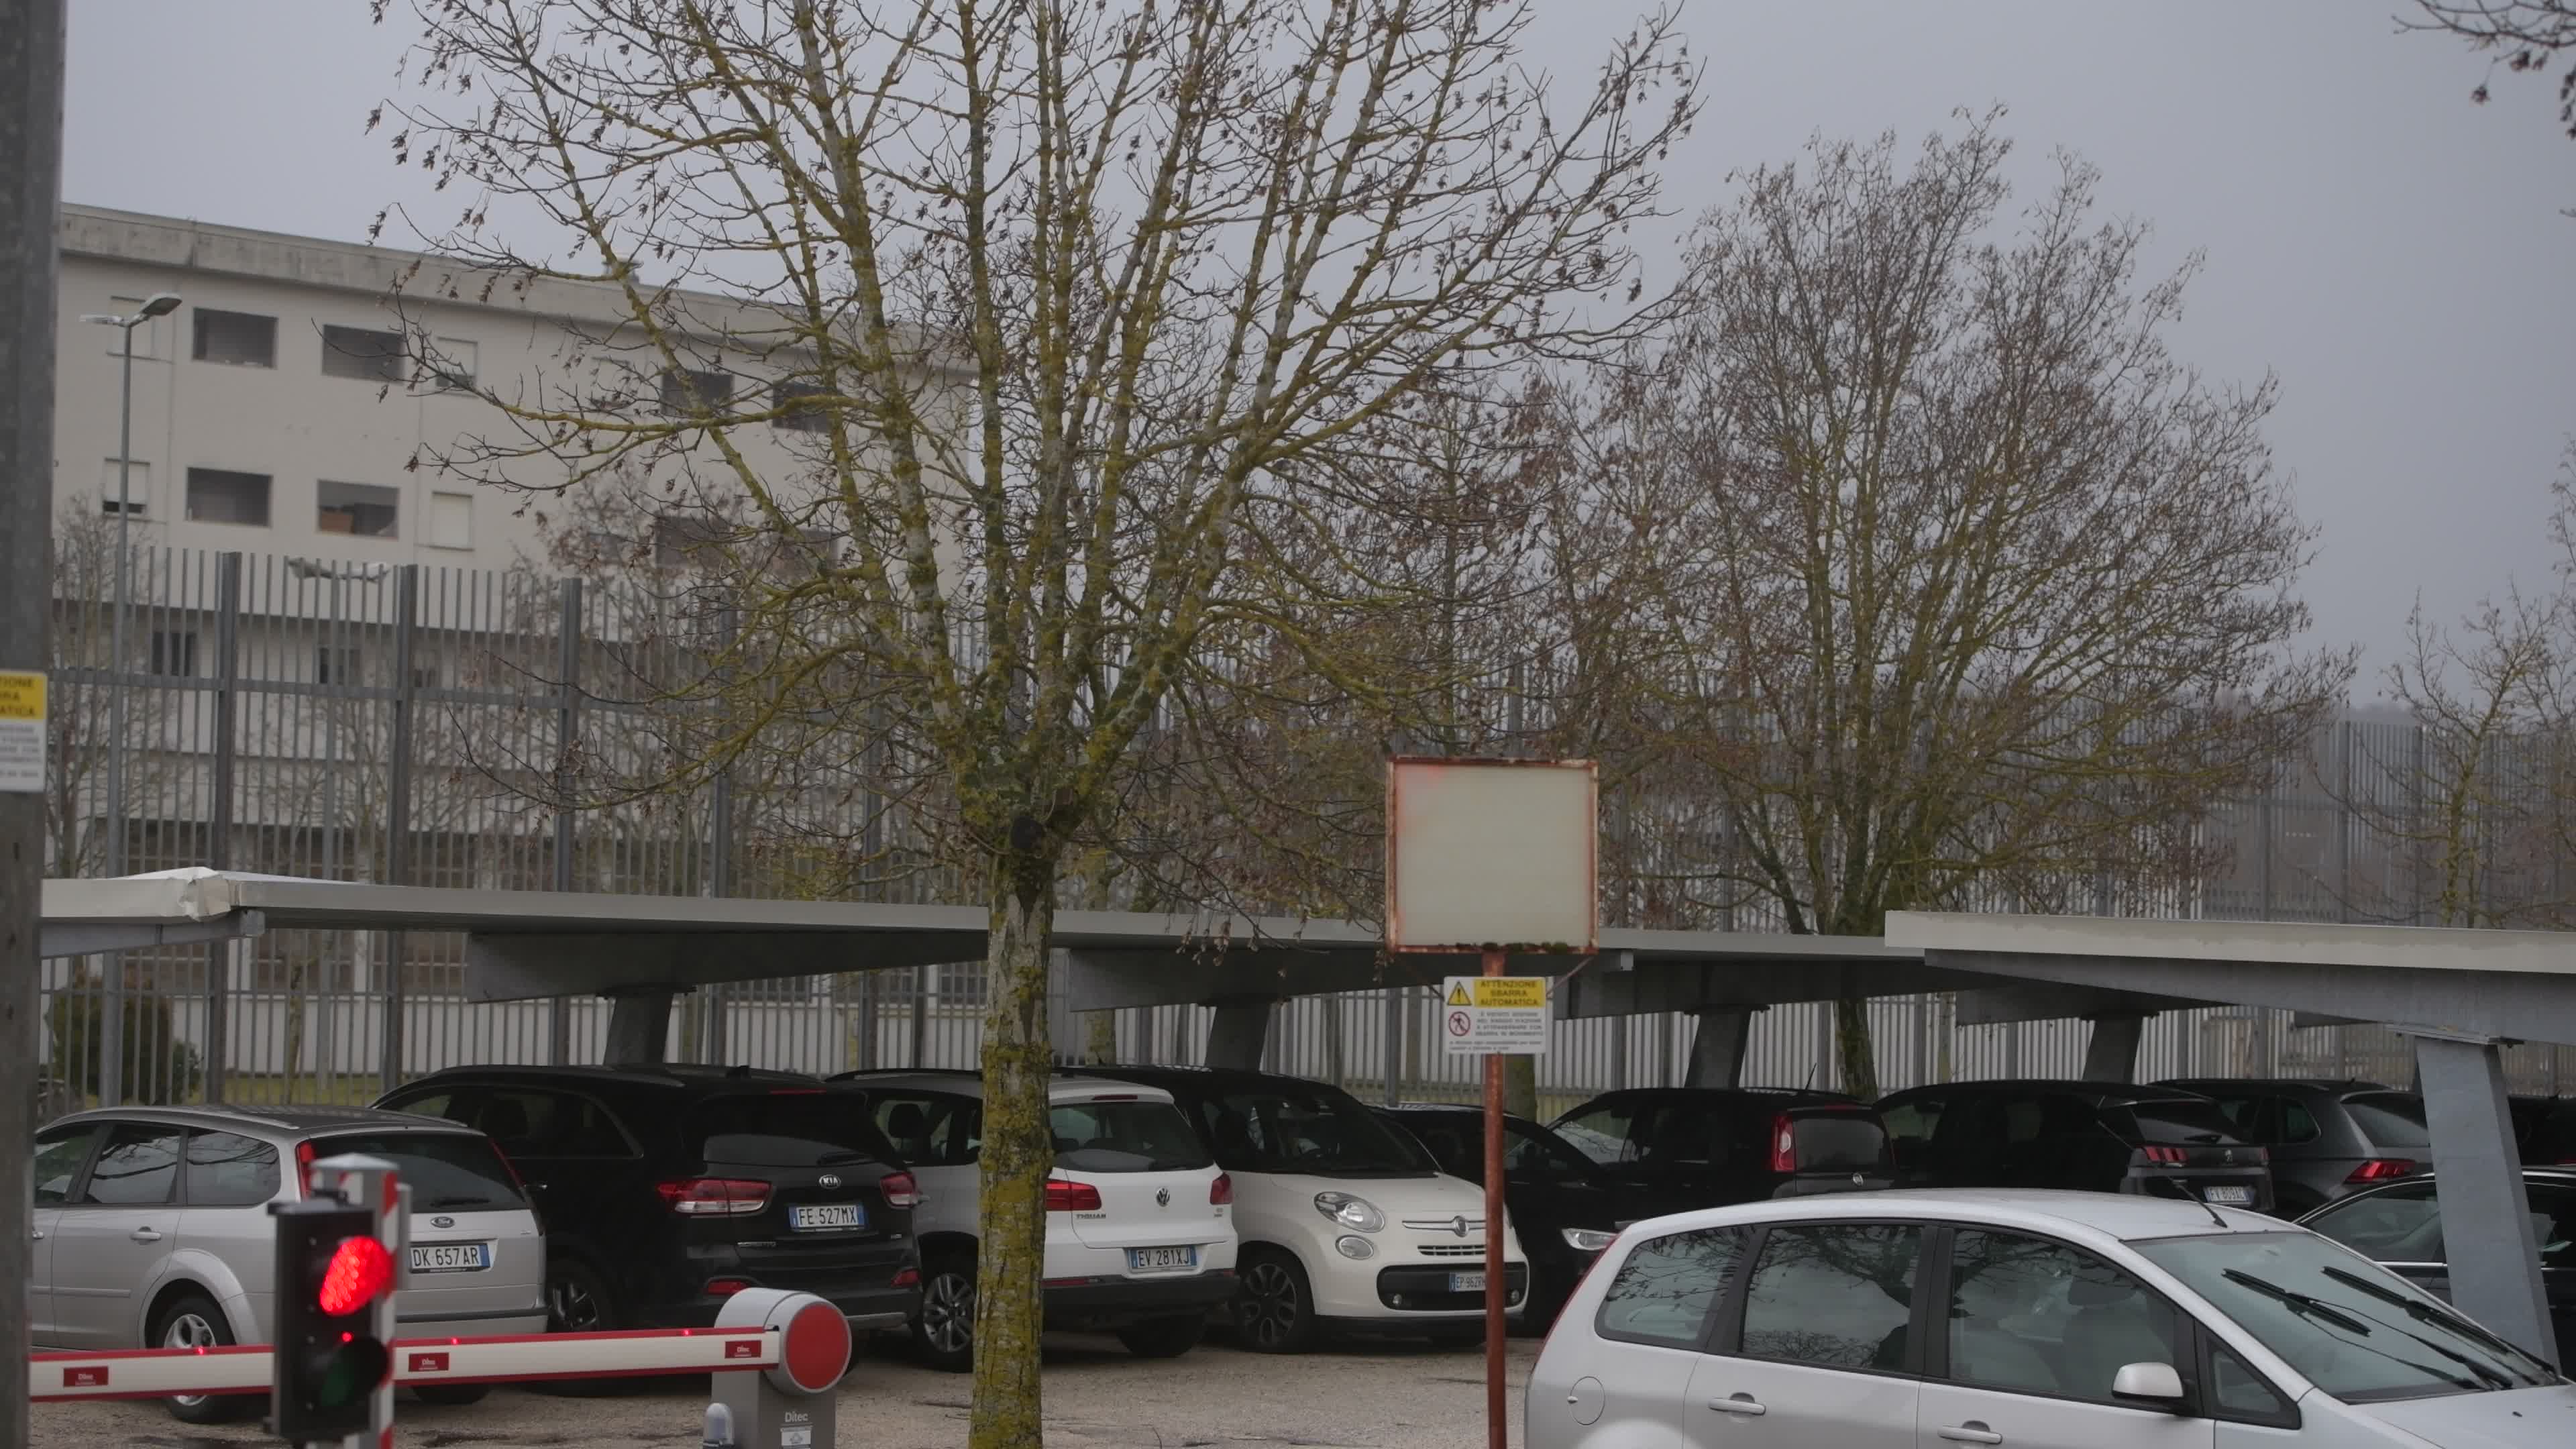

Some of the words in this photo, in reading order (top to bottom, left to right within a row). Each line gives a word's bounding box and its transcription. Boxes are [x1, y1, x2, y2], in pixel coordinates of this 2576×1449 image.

[799, 1208, 814, 1225] FE
[818, 1207, 857, 1224] 527MX
[413, 1249, 431, 1267] DK
[435, 1247, 480, 1265] 657AR
[1138, 1250, 1151, 1267] EV
[1156, 1248, 1190, 1266] 281XJ
[1456, 1277, 1464, 1288] EP
[785, 1411, 808, 1422] Ditec
